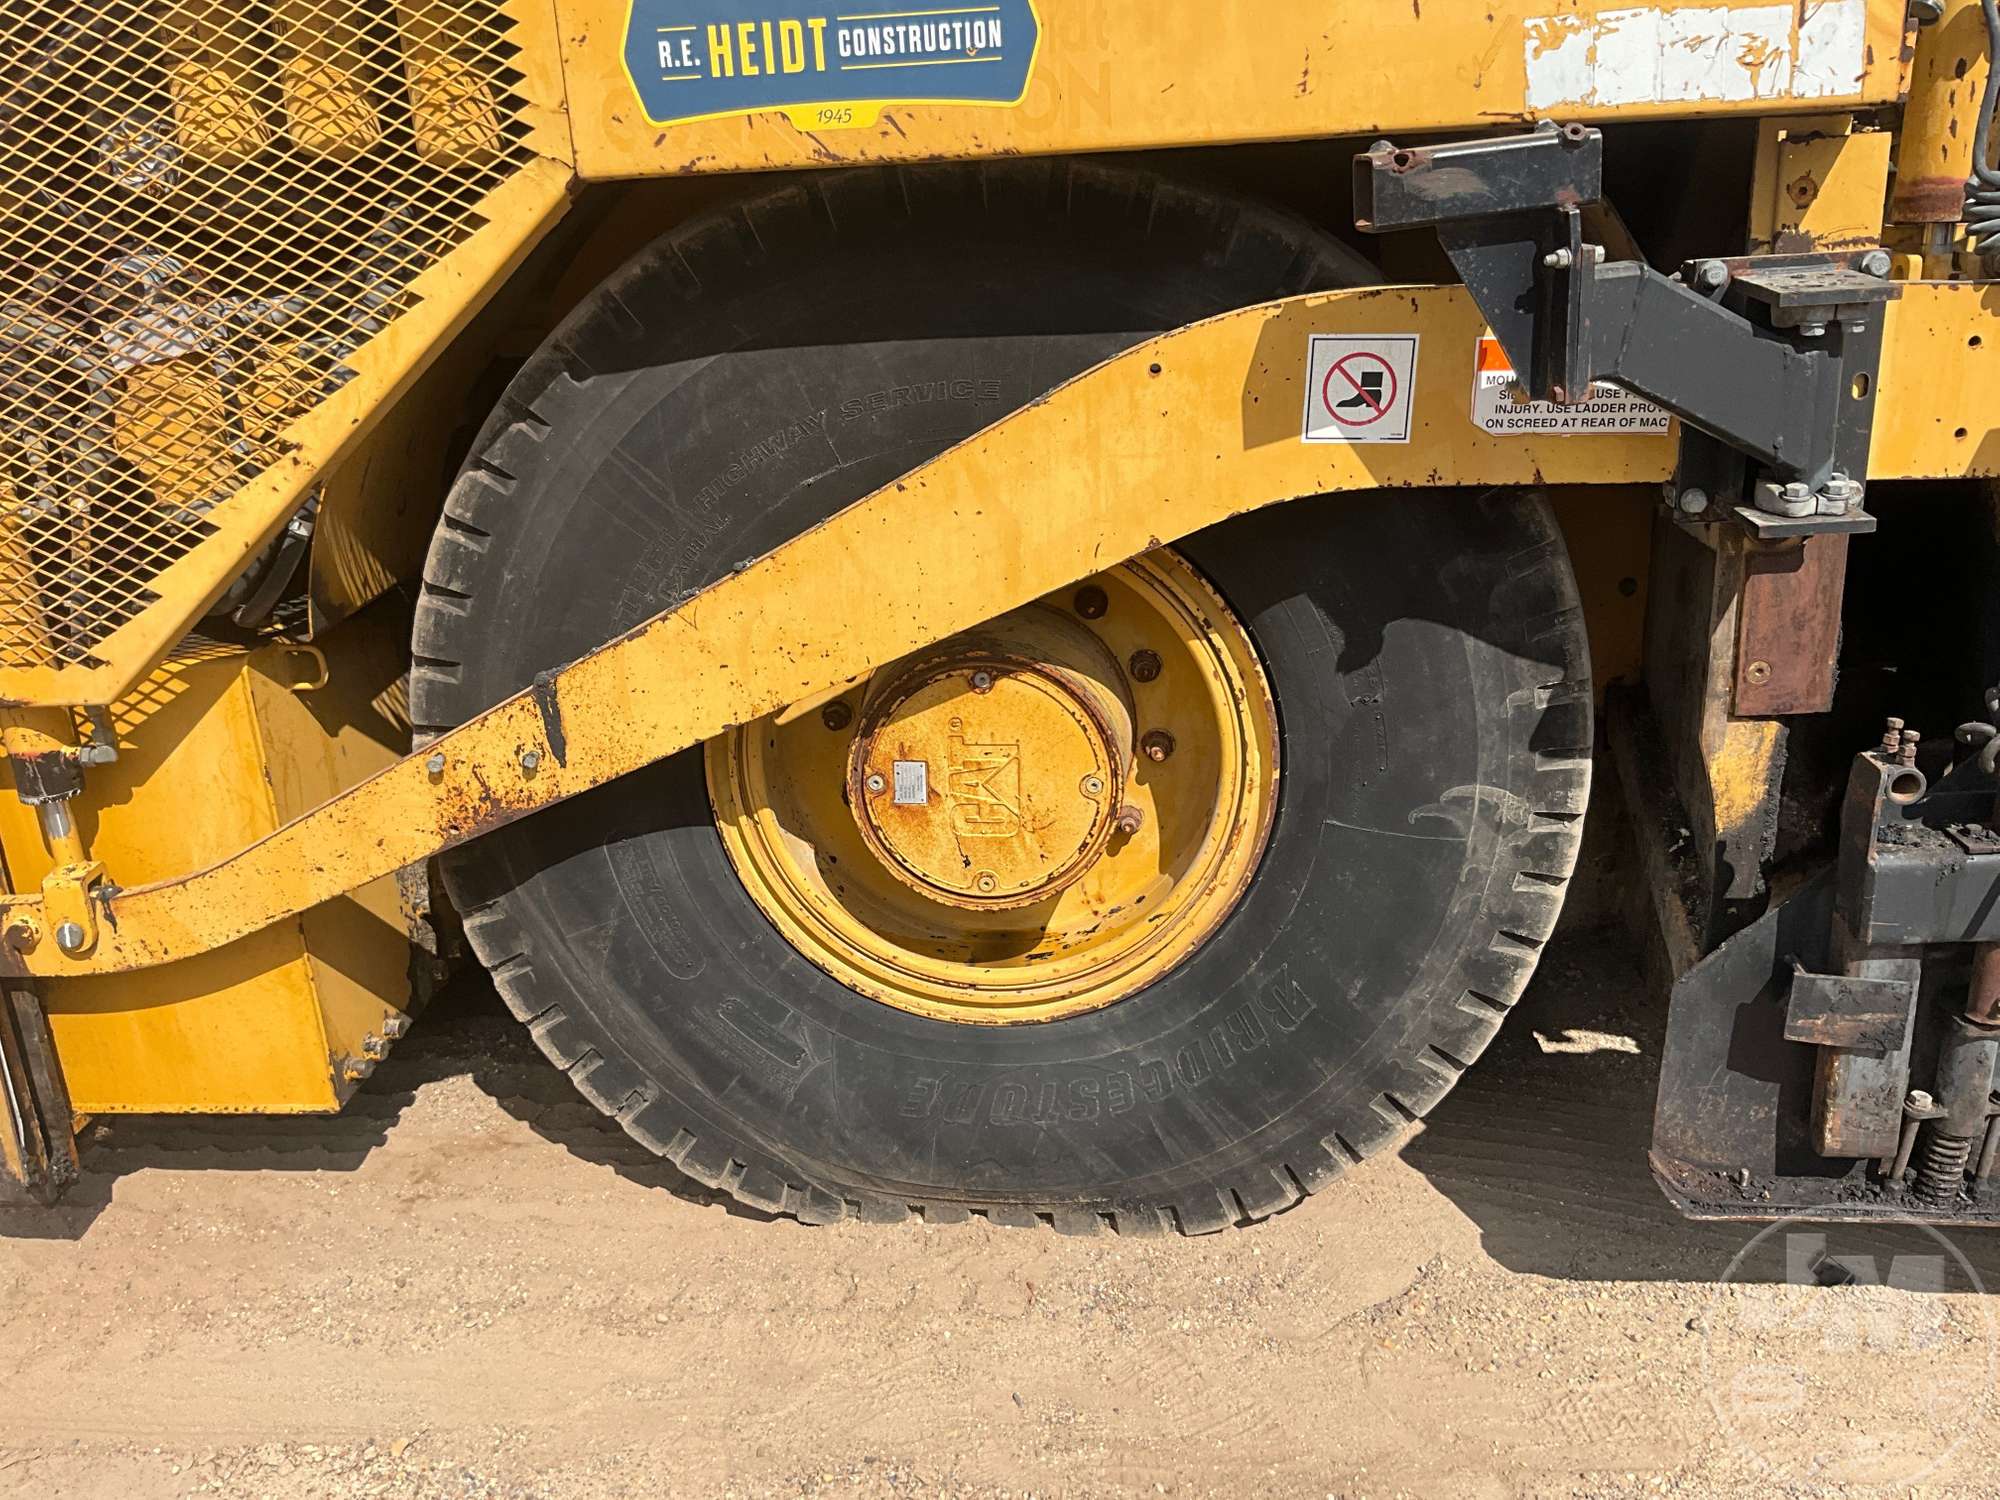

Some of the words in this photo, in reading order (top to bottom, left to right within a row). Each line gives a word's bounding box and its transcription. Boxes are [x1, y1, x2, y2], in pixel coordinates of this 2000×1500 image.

[658, 39, 701, 69] R.E.
[707, 17, 828, 78] HEIDT
[837, 19, 1003, 58] CONSTRUCTION
[816, 107, 853, 125] 1945
[1486, 418, 1504, 428] ON
[1507, 418, 1558, 428] SCREED
[1561, 418, 1578, 428] AT
[1581, 418, 1616, 428] REAR
[1620, 418, 1637, 428] OF
[1640, 417, 1668, 428] MAC
[1495, 404, 1542, 414] INJURY.
[1547, 403, 1572, 414] USE
[1575, 403, 1626, 413] LADDER
[694, 411, 827, 513] HIGHWAY
[840, 378, 1001, 425] SERVICE
[948, 736, 1020, 837] CAT
